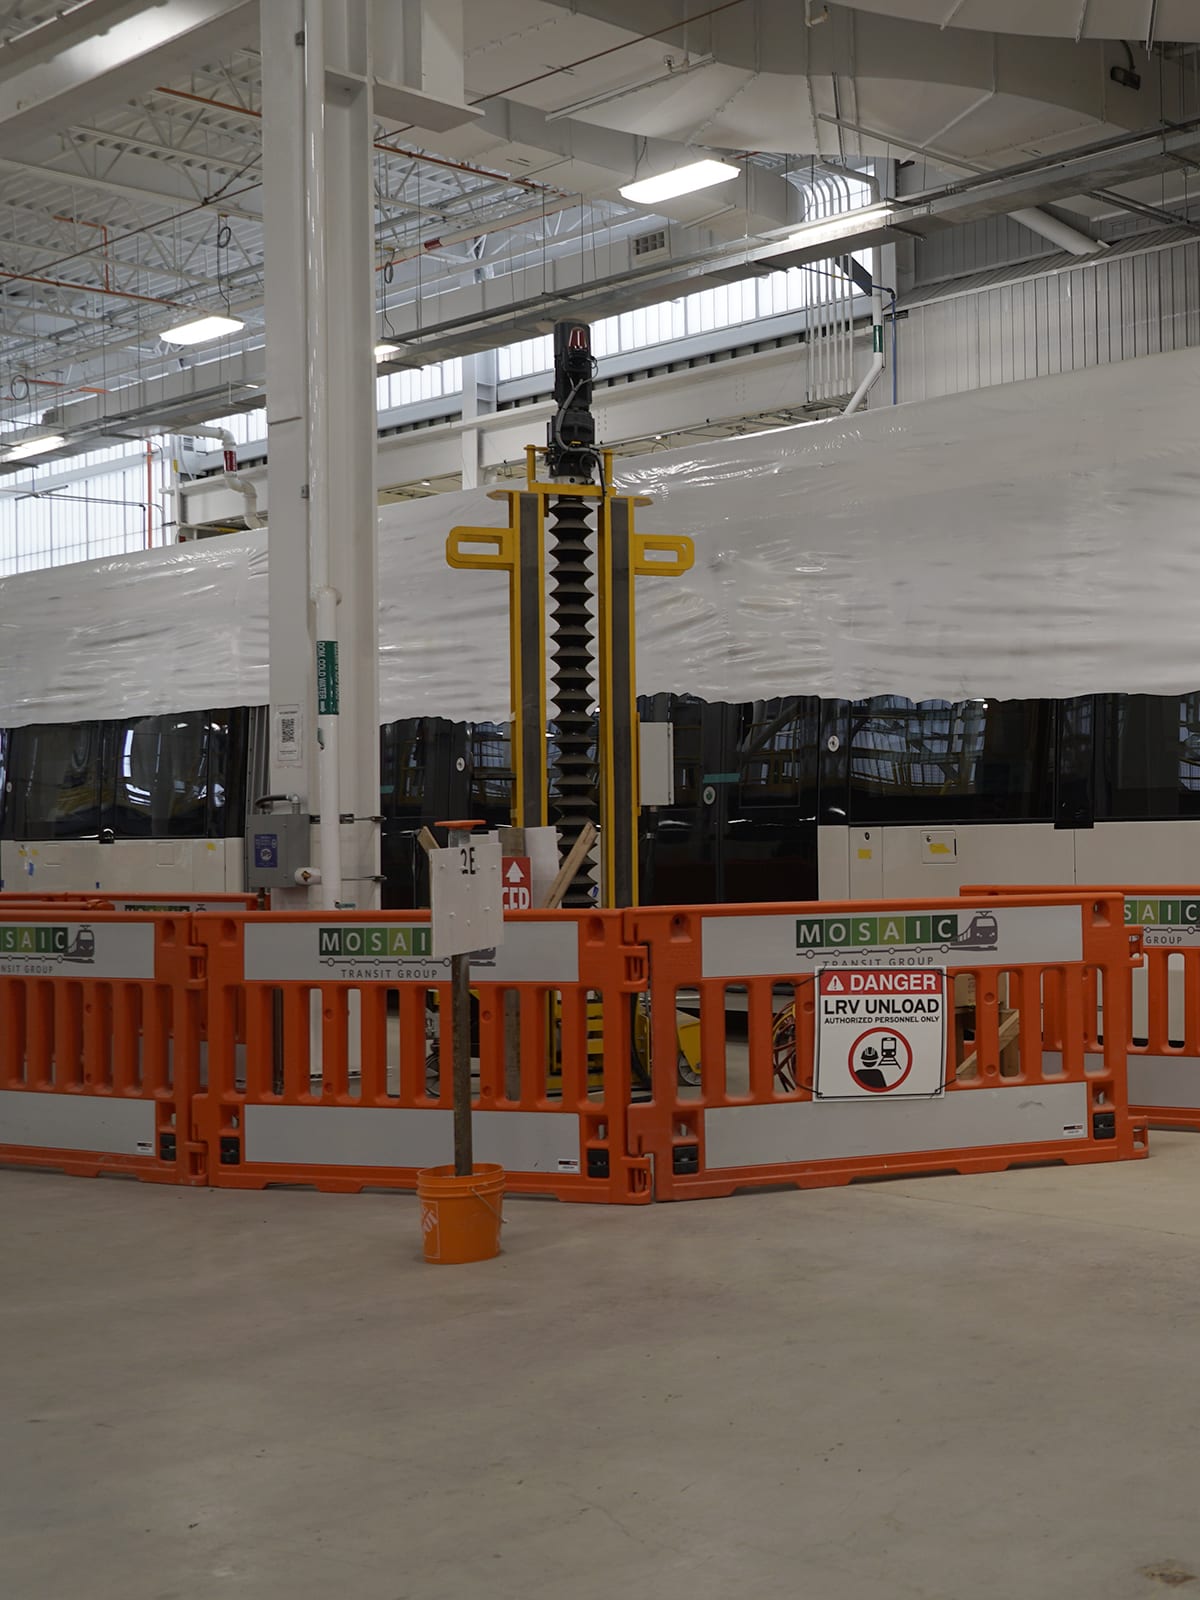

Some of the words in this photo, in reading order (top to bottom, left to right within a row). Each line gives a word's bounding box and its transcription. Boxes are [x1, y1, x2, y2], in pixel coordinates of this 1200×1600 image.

[318, 659, 327, 677] COLD
[319, 677, 327, 699] WATER
[1124, 904, 1197, 921] SAIC
[5, 931, 65, 949] SAIC
[800, 919, 952, 944] MOSAIC
[1145, 936, 1182, 944] GROUP
[322, 932, 426, 951] MOSAI
[0, 964, 20, 973] NSIT
[24, 965, 53, 974] GROUP
[889, 957, 934, 966] GROUP
[341, 969, 391, 978] TRANSIT
[397, 969, 438, 978] GROUP
[849, 974, 936, 991] DANGER
[824, 999, 860, 1015] LRV
[865, 999, 940, 1014] UNLOAD
[824, 1017, 873, 1025] AUTHORIZED
[875, 1016, 919, 1024] PERSONNEL
